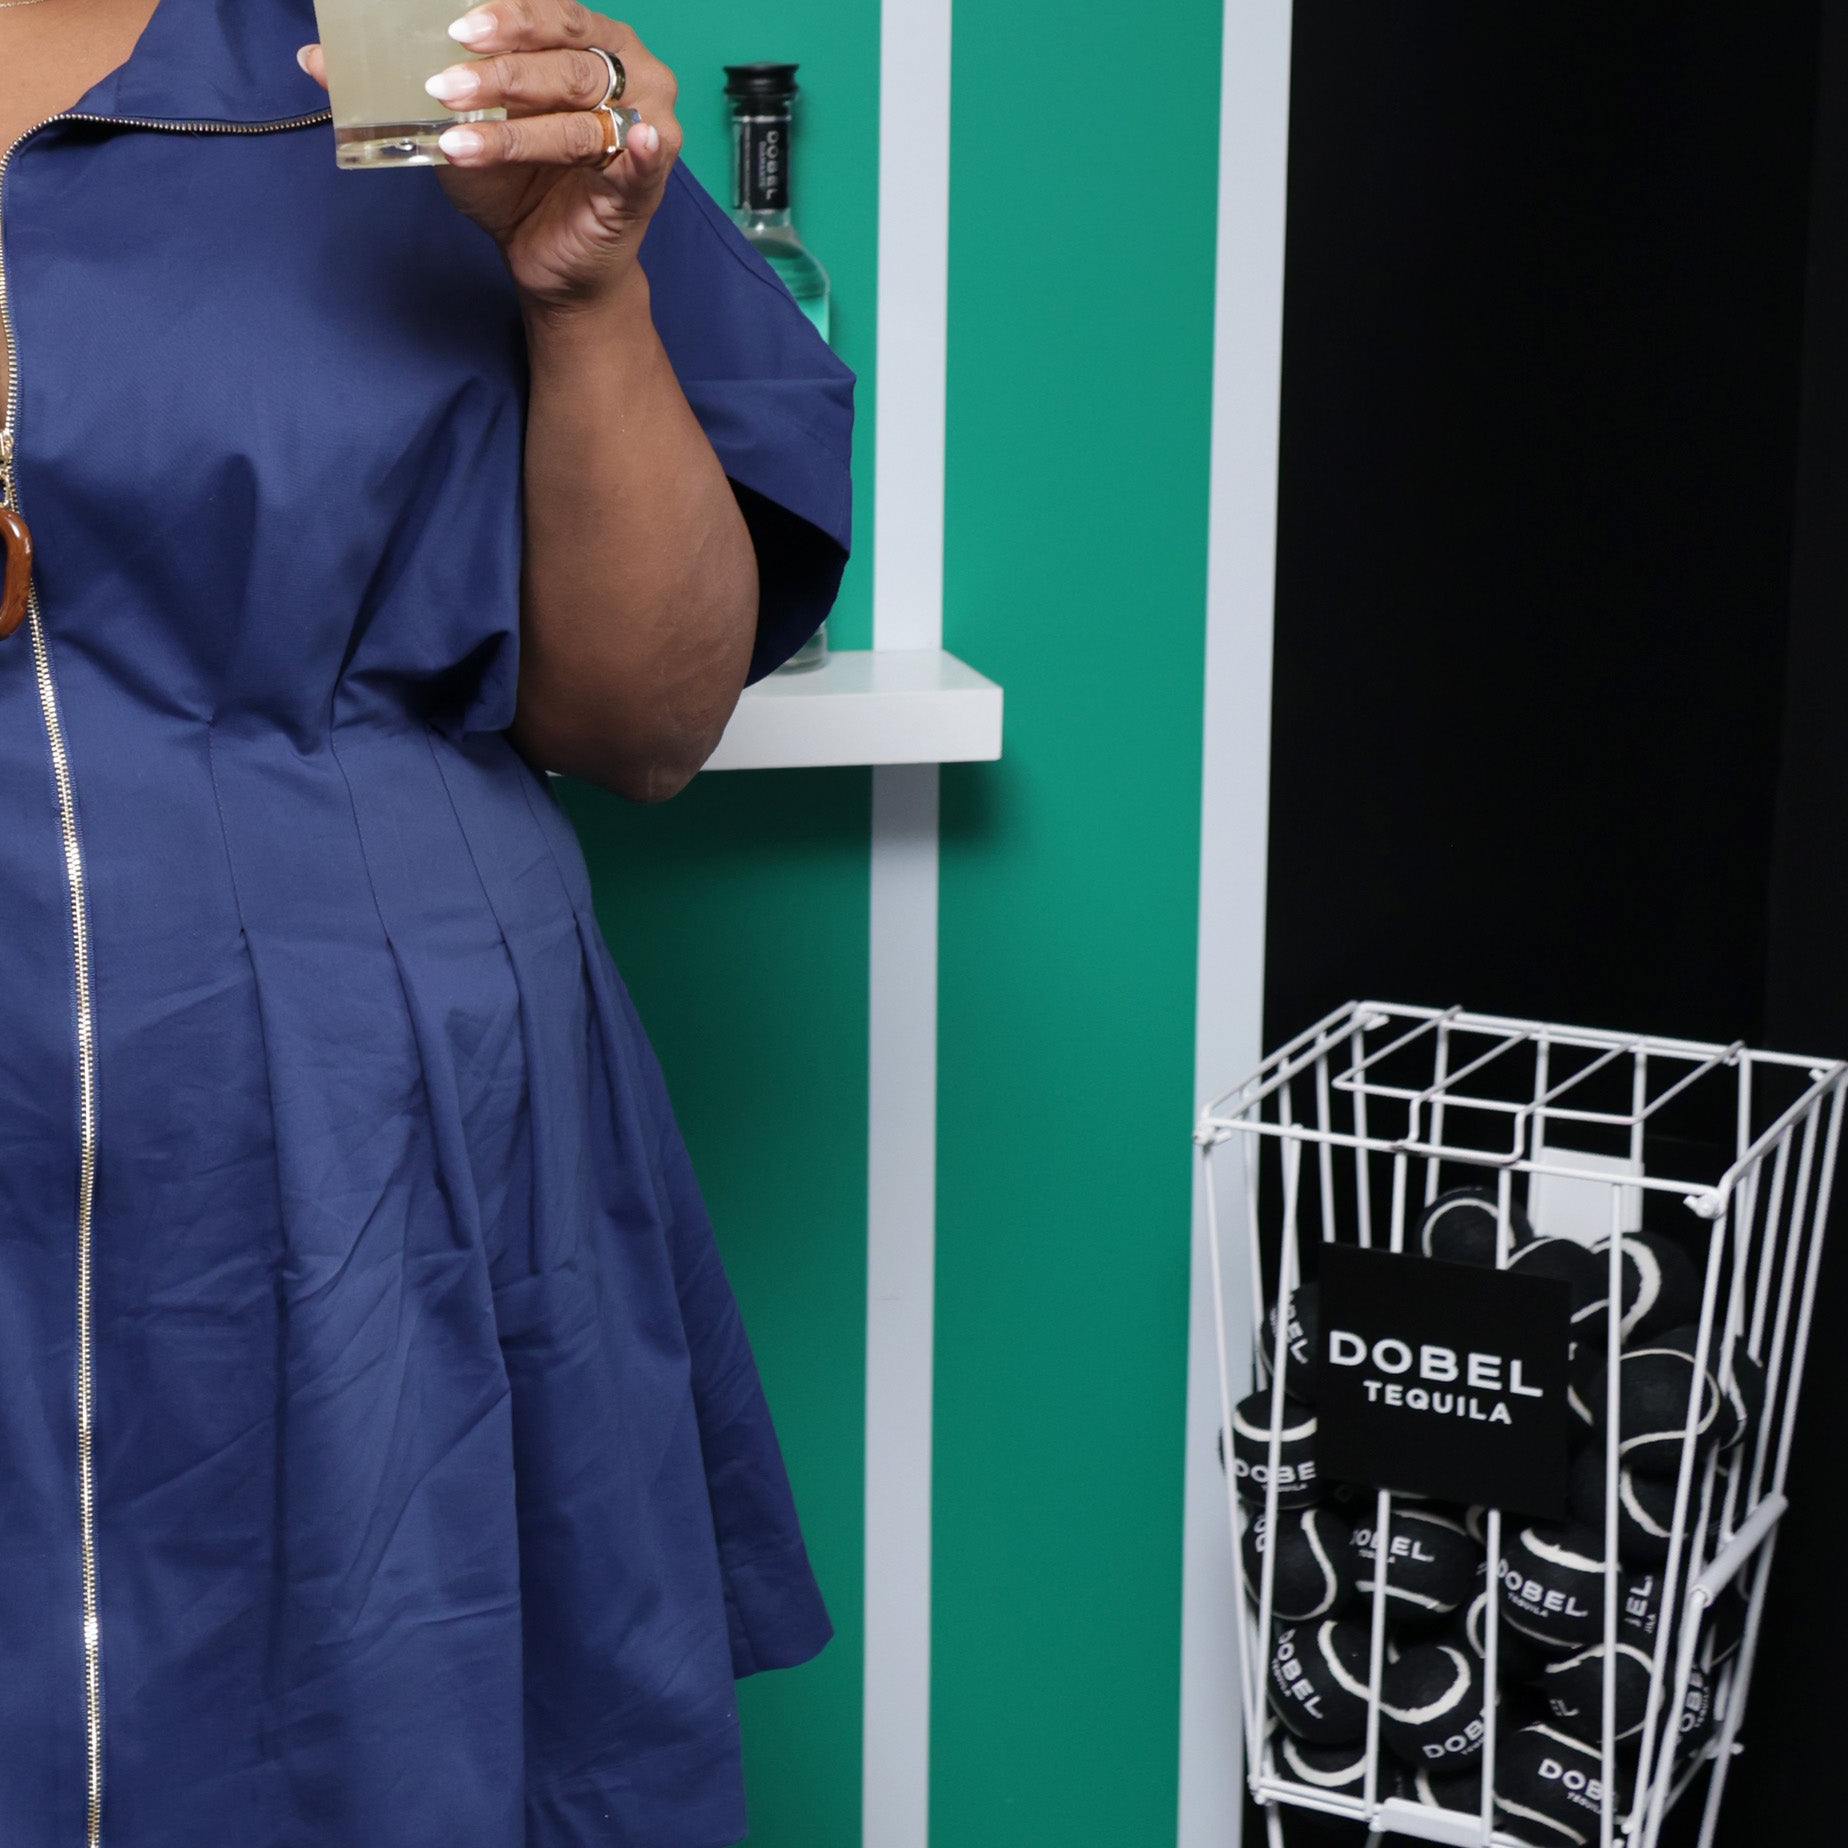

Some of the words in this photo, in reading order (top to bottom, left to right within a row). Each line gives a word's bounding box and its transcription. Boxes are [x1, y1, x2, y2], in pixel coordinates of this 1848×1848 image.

[1329, 1329, 1544, 1398] DOBEL
[1363, 1379, 1513, 1425] TEQUILA
[1422, 1708, 1484, 1759] DOB
